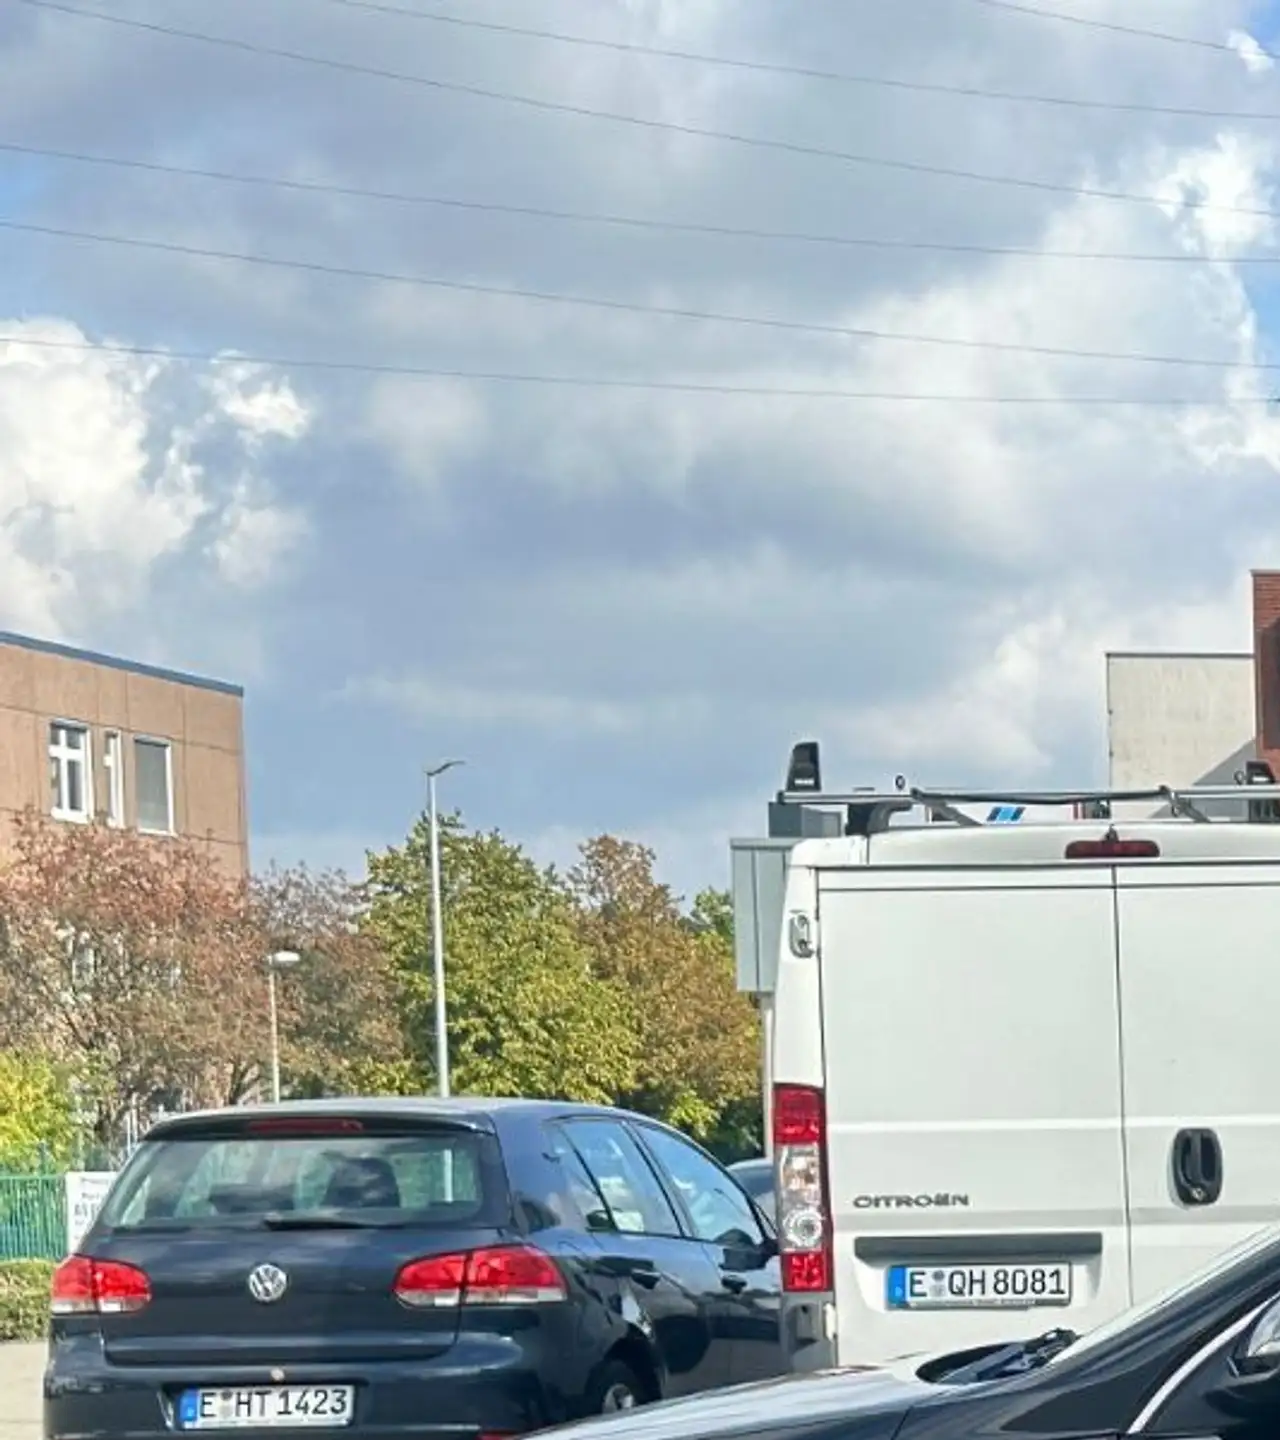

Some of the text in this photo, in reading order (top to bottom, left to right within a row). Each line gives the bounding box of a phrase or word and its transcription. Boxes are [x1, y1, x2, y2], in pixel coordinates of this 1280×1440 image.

[909, 1270, 928, 1297] E
[992, 1268, 1066, 1296] 8081
[201, 1389, 348, 1418] E HT 1423
